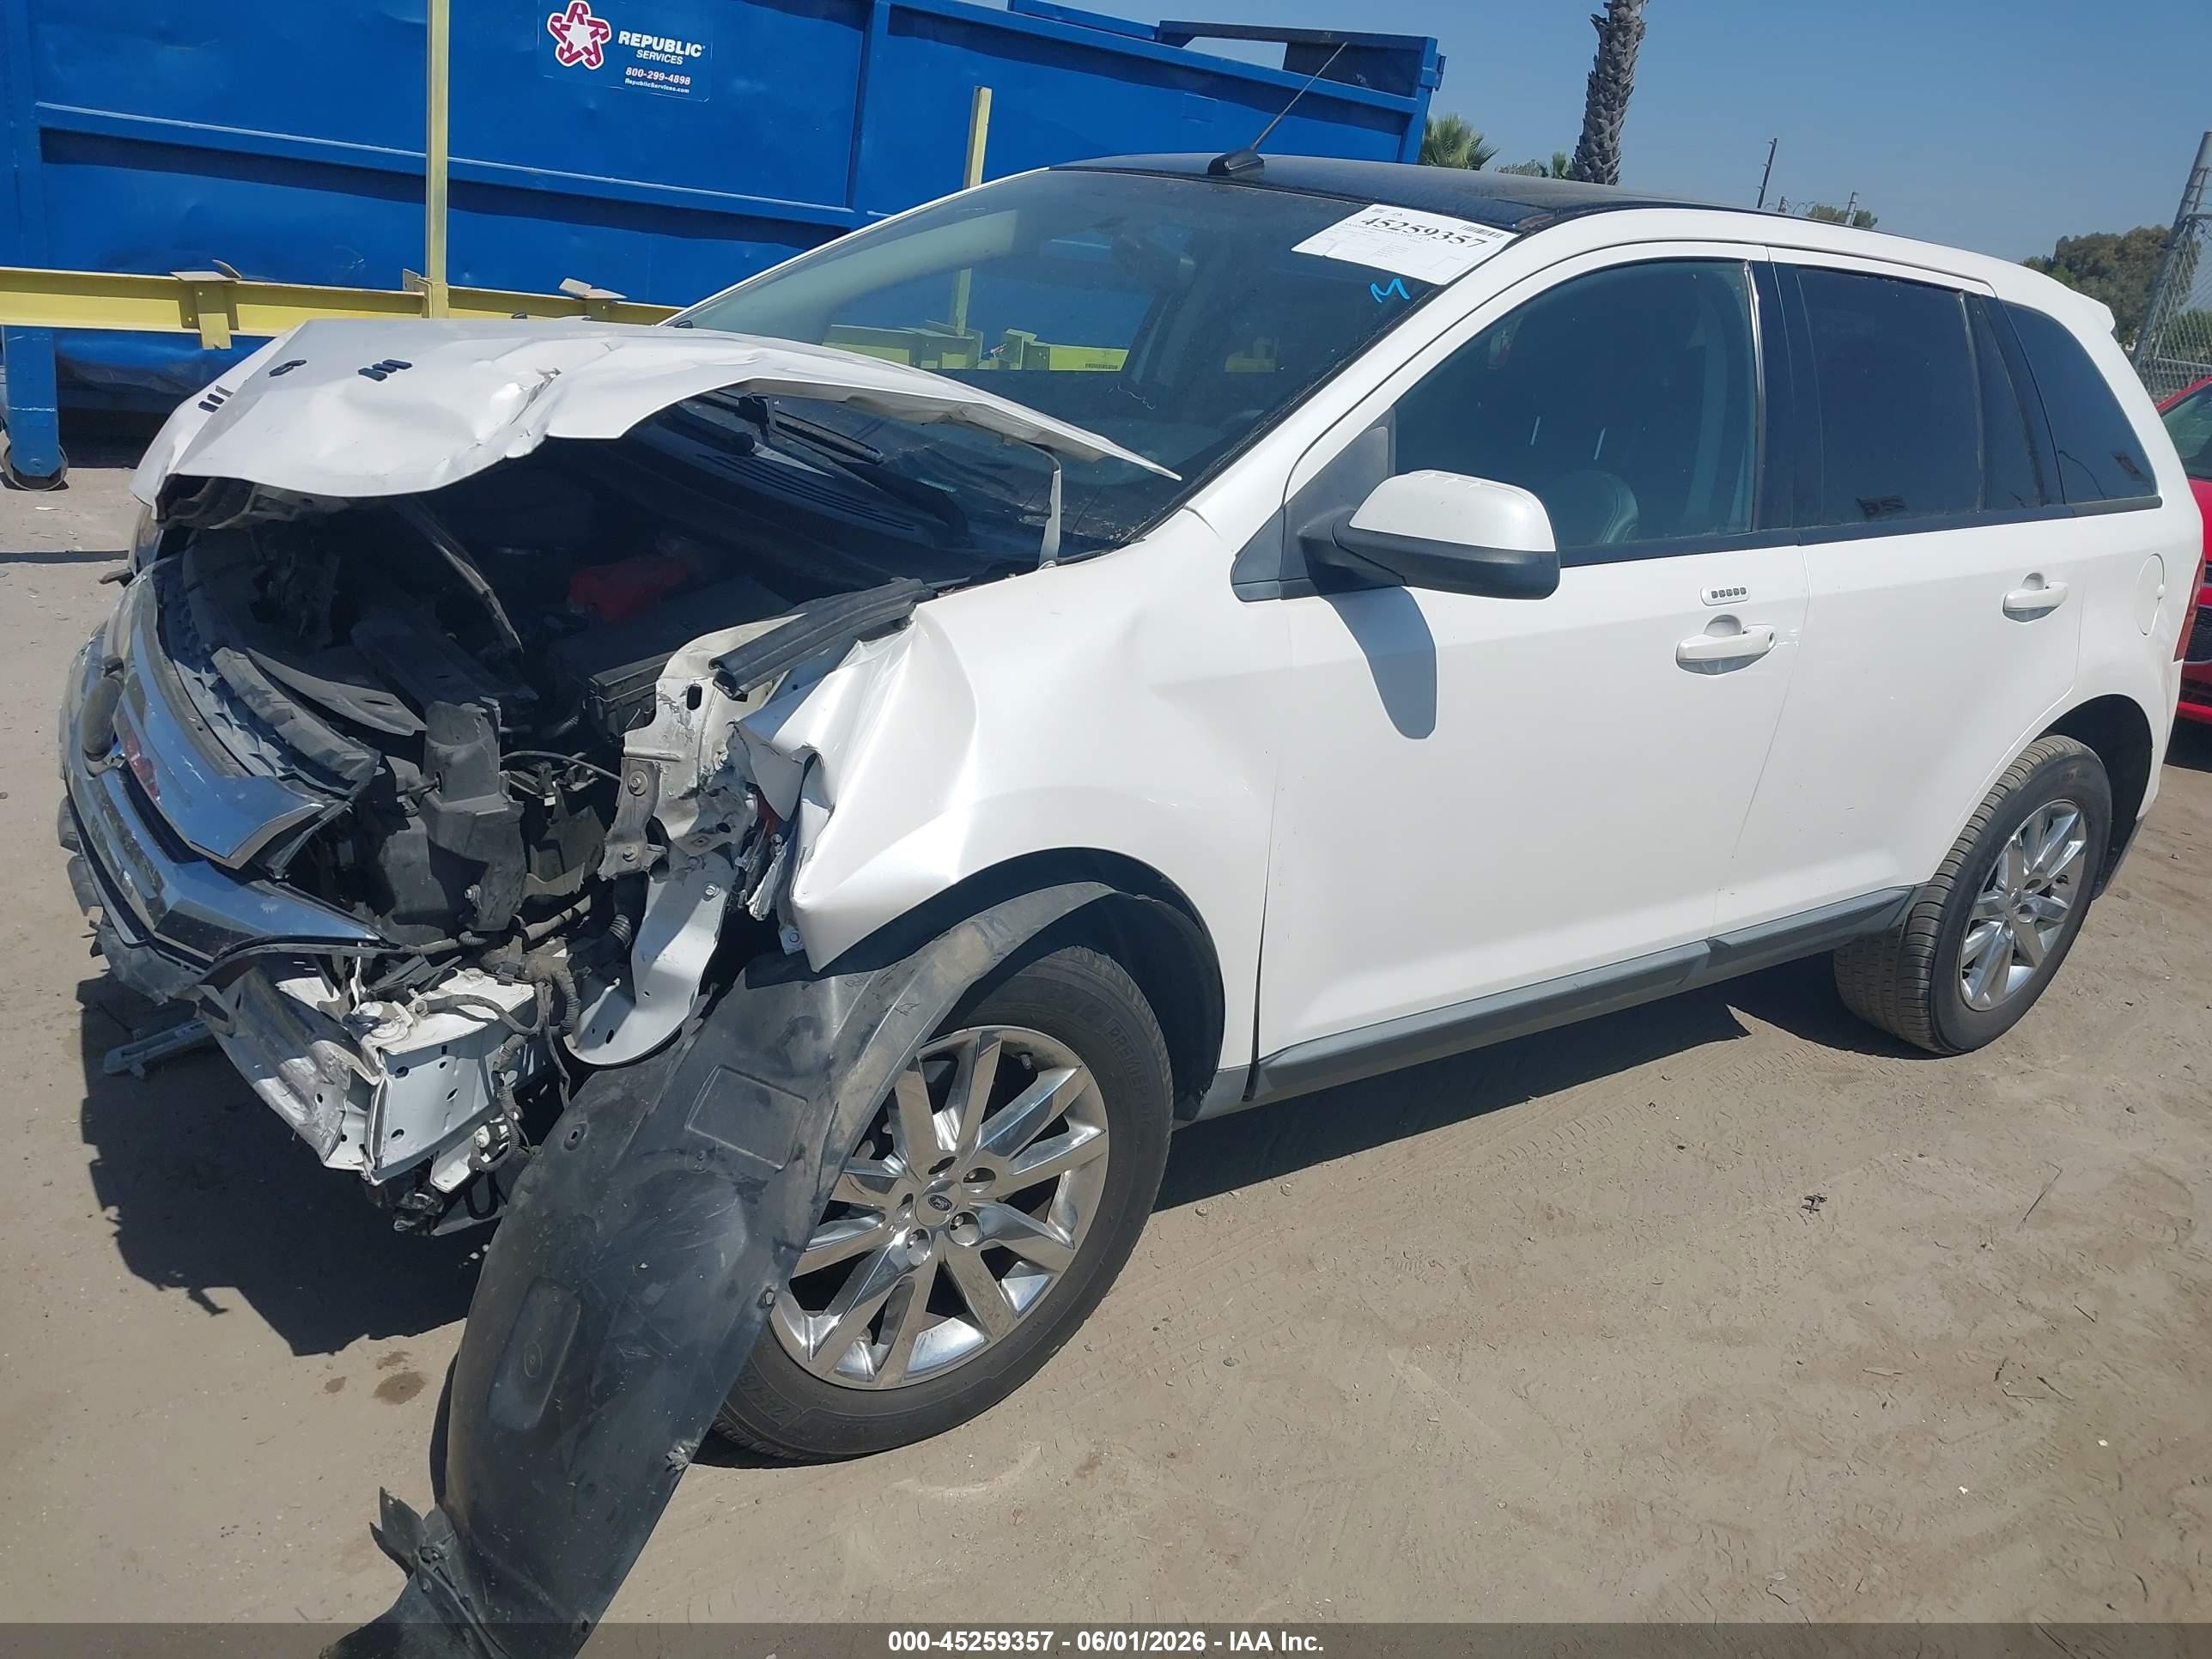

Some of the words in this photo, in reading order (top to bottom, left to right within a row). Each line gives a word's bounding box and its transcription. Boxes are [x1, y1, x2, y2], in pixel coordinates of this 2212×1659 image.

[618, 31, 702, 58] REPUBLIC
[636, 50, 684, 65] SERVICES
[625, 67, 691, 85] 800-299-4898
[625, 78, 690, 94] RepublicServices.com
[1361, 217, 1488, 248] 45259357
[1370, 277, 1410, 303] M
